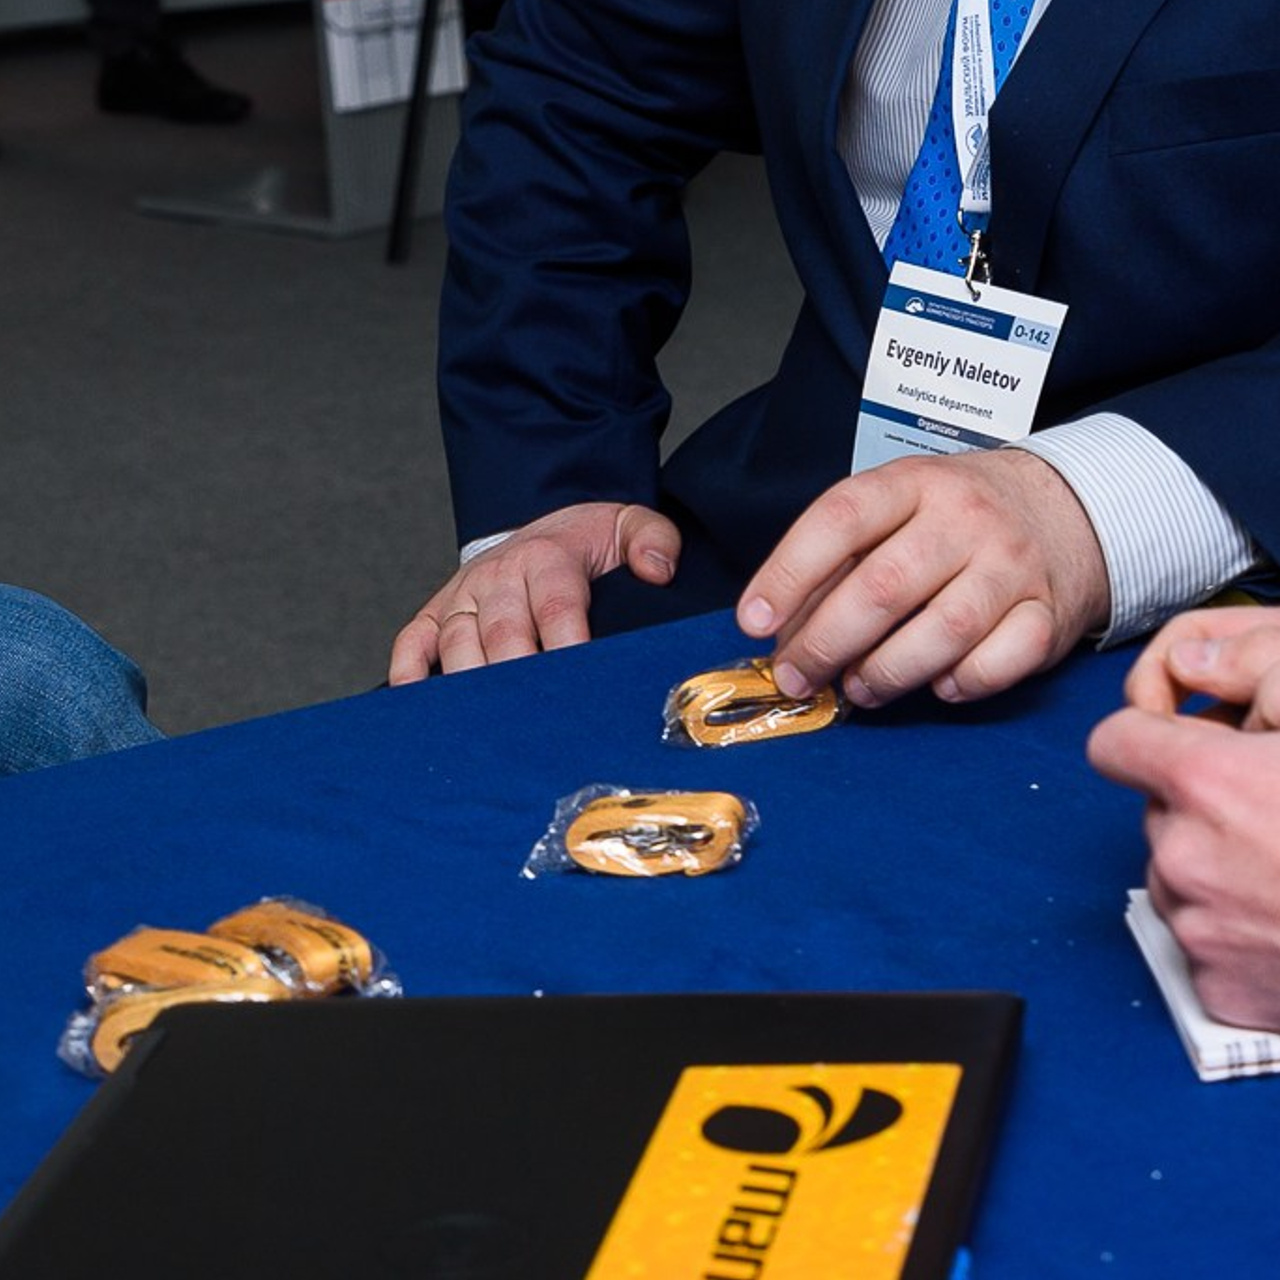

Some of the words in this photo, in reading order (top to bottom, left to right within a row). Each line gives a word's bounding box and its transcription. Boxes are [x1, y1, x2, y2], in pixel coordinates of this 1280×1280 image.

[1014, 324, 1051, 346] O-142
[886, 338, 951, 377] Evgeniy
[952, 356, 1021, 393] Naletov
[896, 383, 938, 404] Analytics
[938, 394, 993, 420] department
